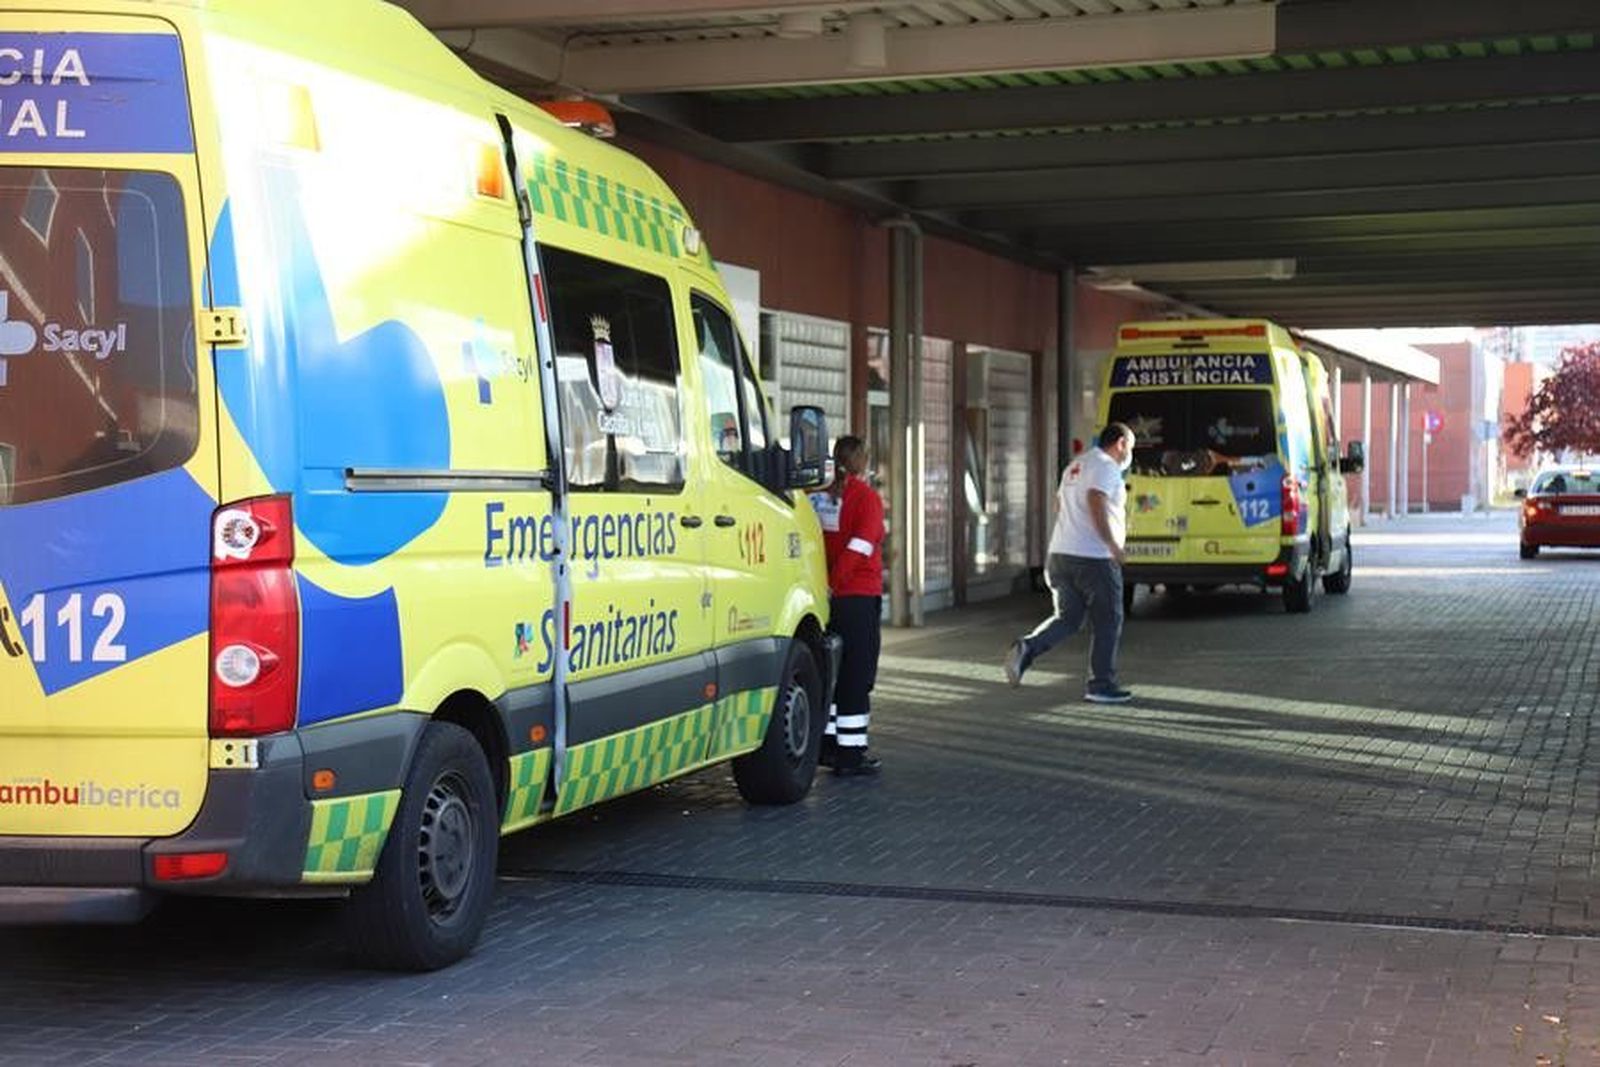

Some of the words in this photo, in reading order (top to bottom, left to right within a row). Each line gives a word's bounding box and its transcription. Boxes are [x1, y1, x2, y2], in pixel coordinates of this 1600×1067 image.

[0, 99, 86, 138] AL
[43, 323, 127, 360] Sacyl
[1126, 354, 1256, 371] AMBULANCIA
[1239, 500, 1269, 518] 112
[745, 521, 766, 567] 112
[21, 592, 126, 662] 112
[537, 598, 677, 674] Sanitarias
